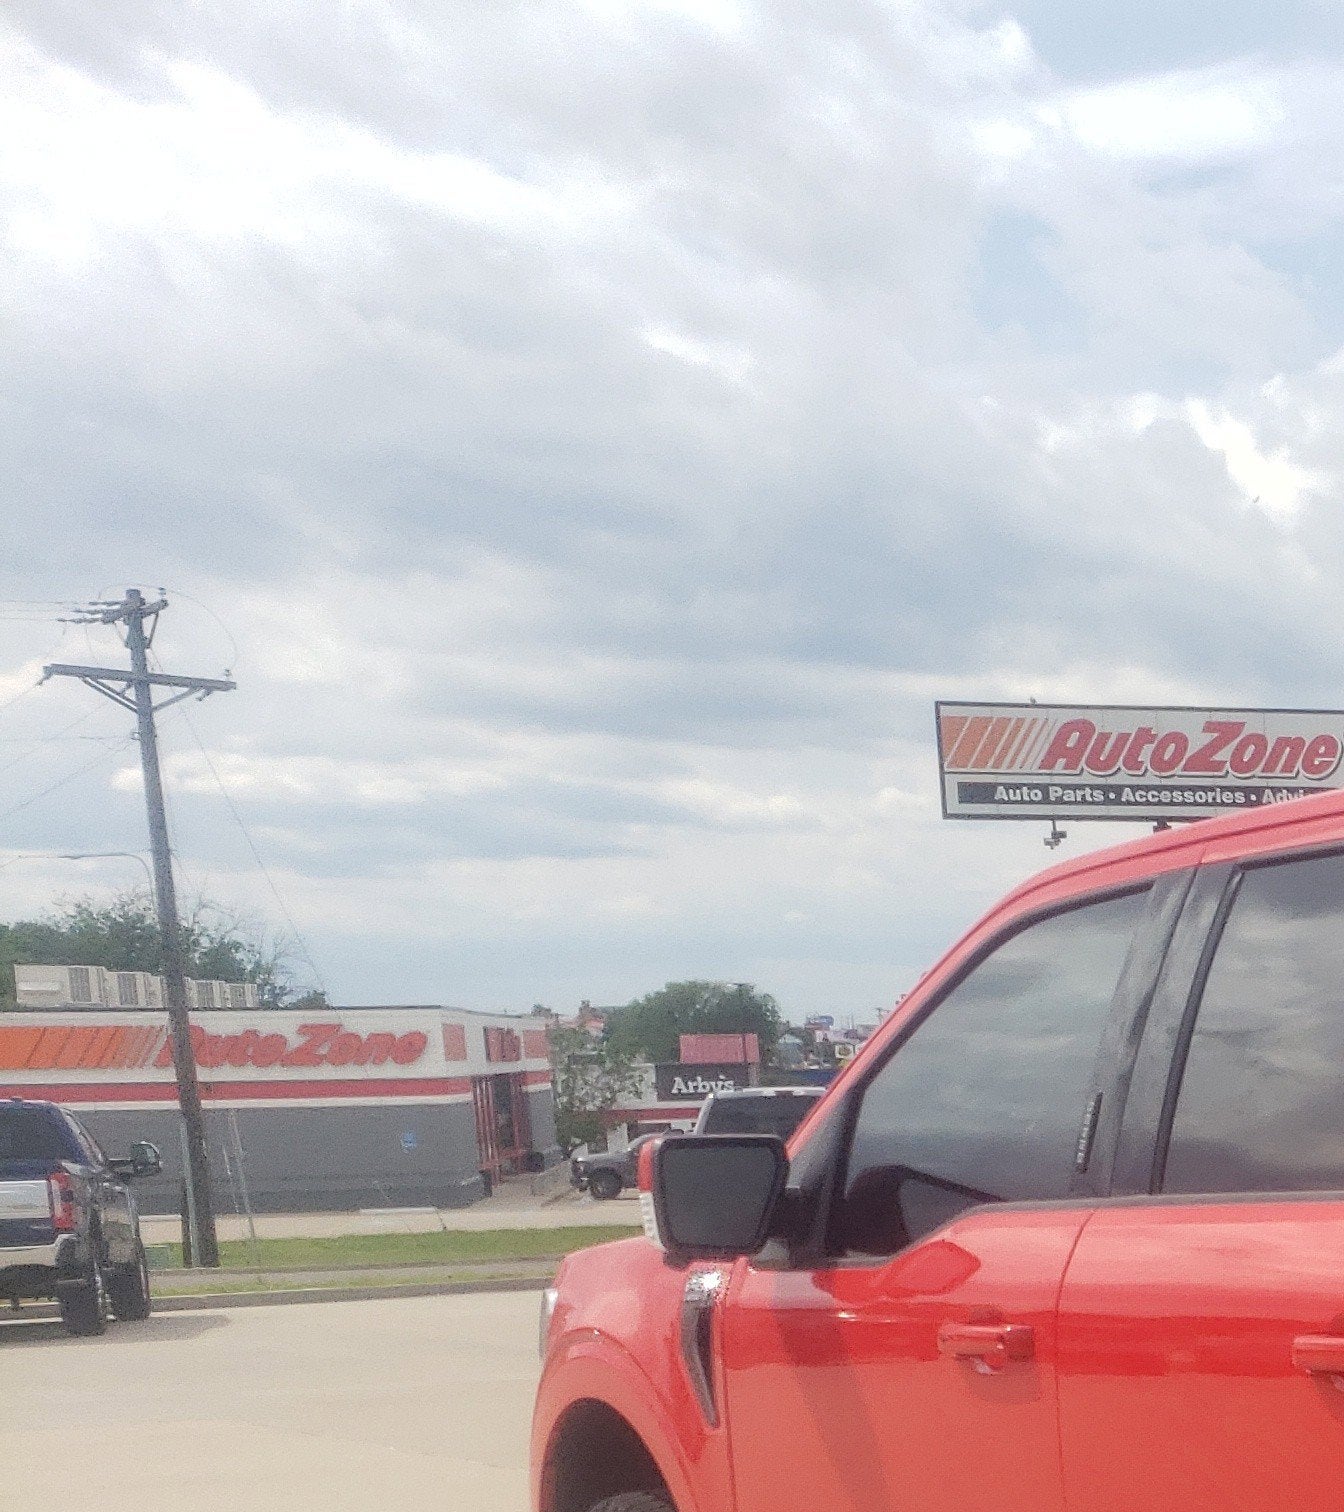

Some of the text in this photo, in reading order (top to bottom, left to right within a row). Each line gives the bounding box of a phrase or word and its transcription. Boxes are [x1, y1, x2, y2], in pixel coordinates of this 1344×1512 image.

[1038, 717, 1344, 779] AutoZone
[994, 785, 1043, 802] Auto
[1048, 786, 1105, 803] Parts
[1120, 787, 1246, 805] Accessories
[670, 1074, 736, 1094] Arby's
